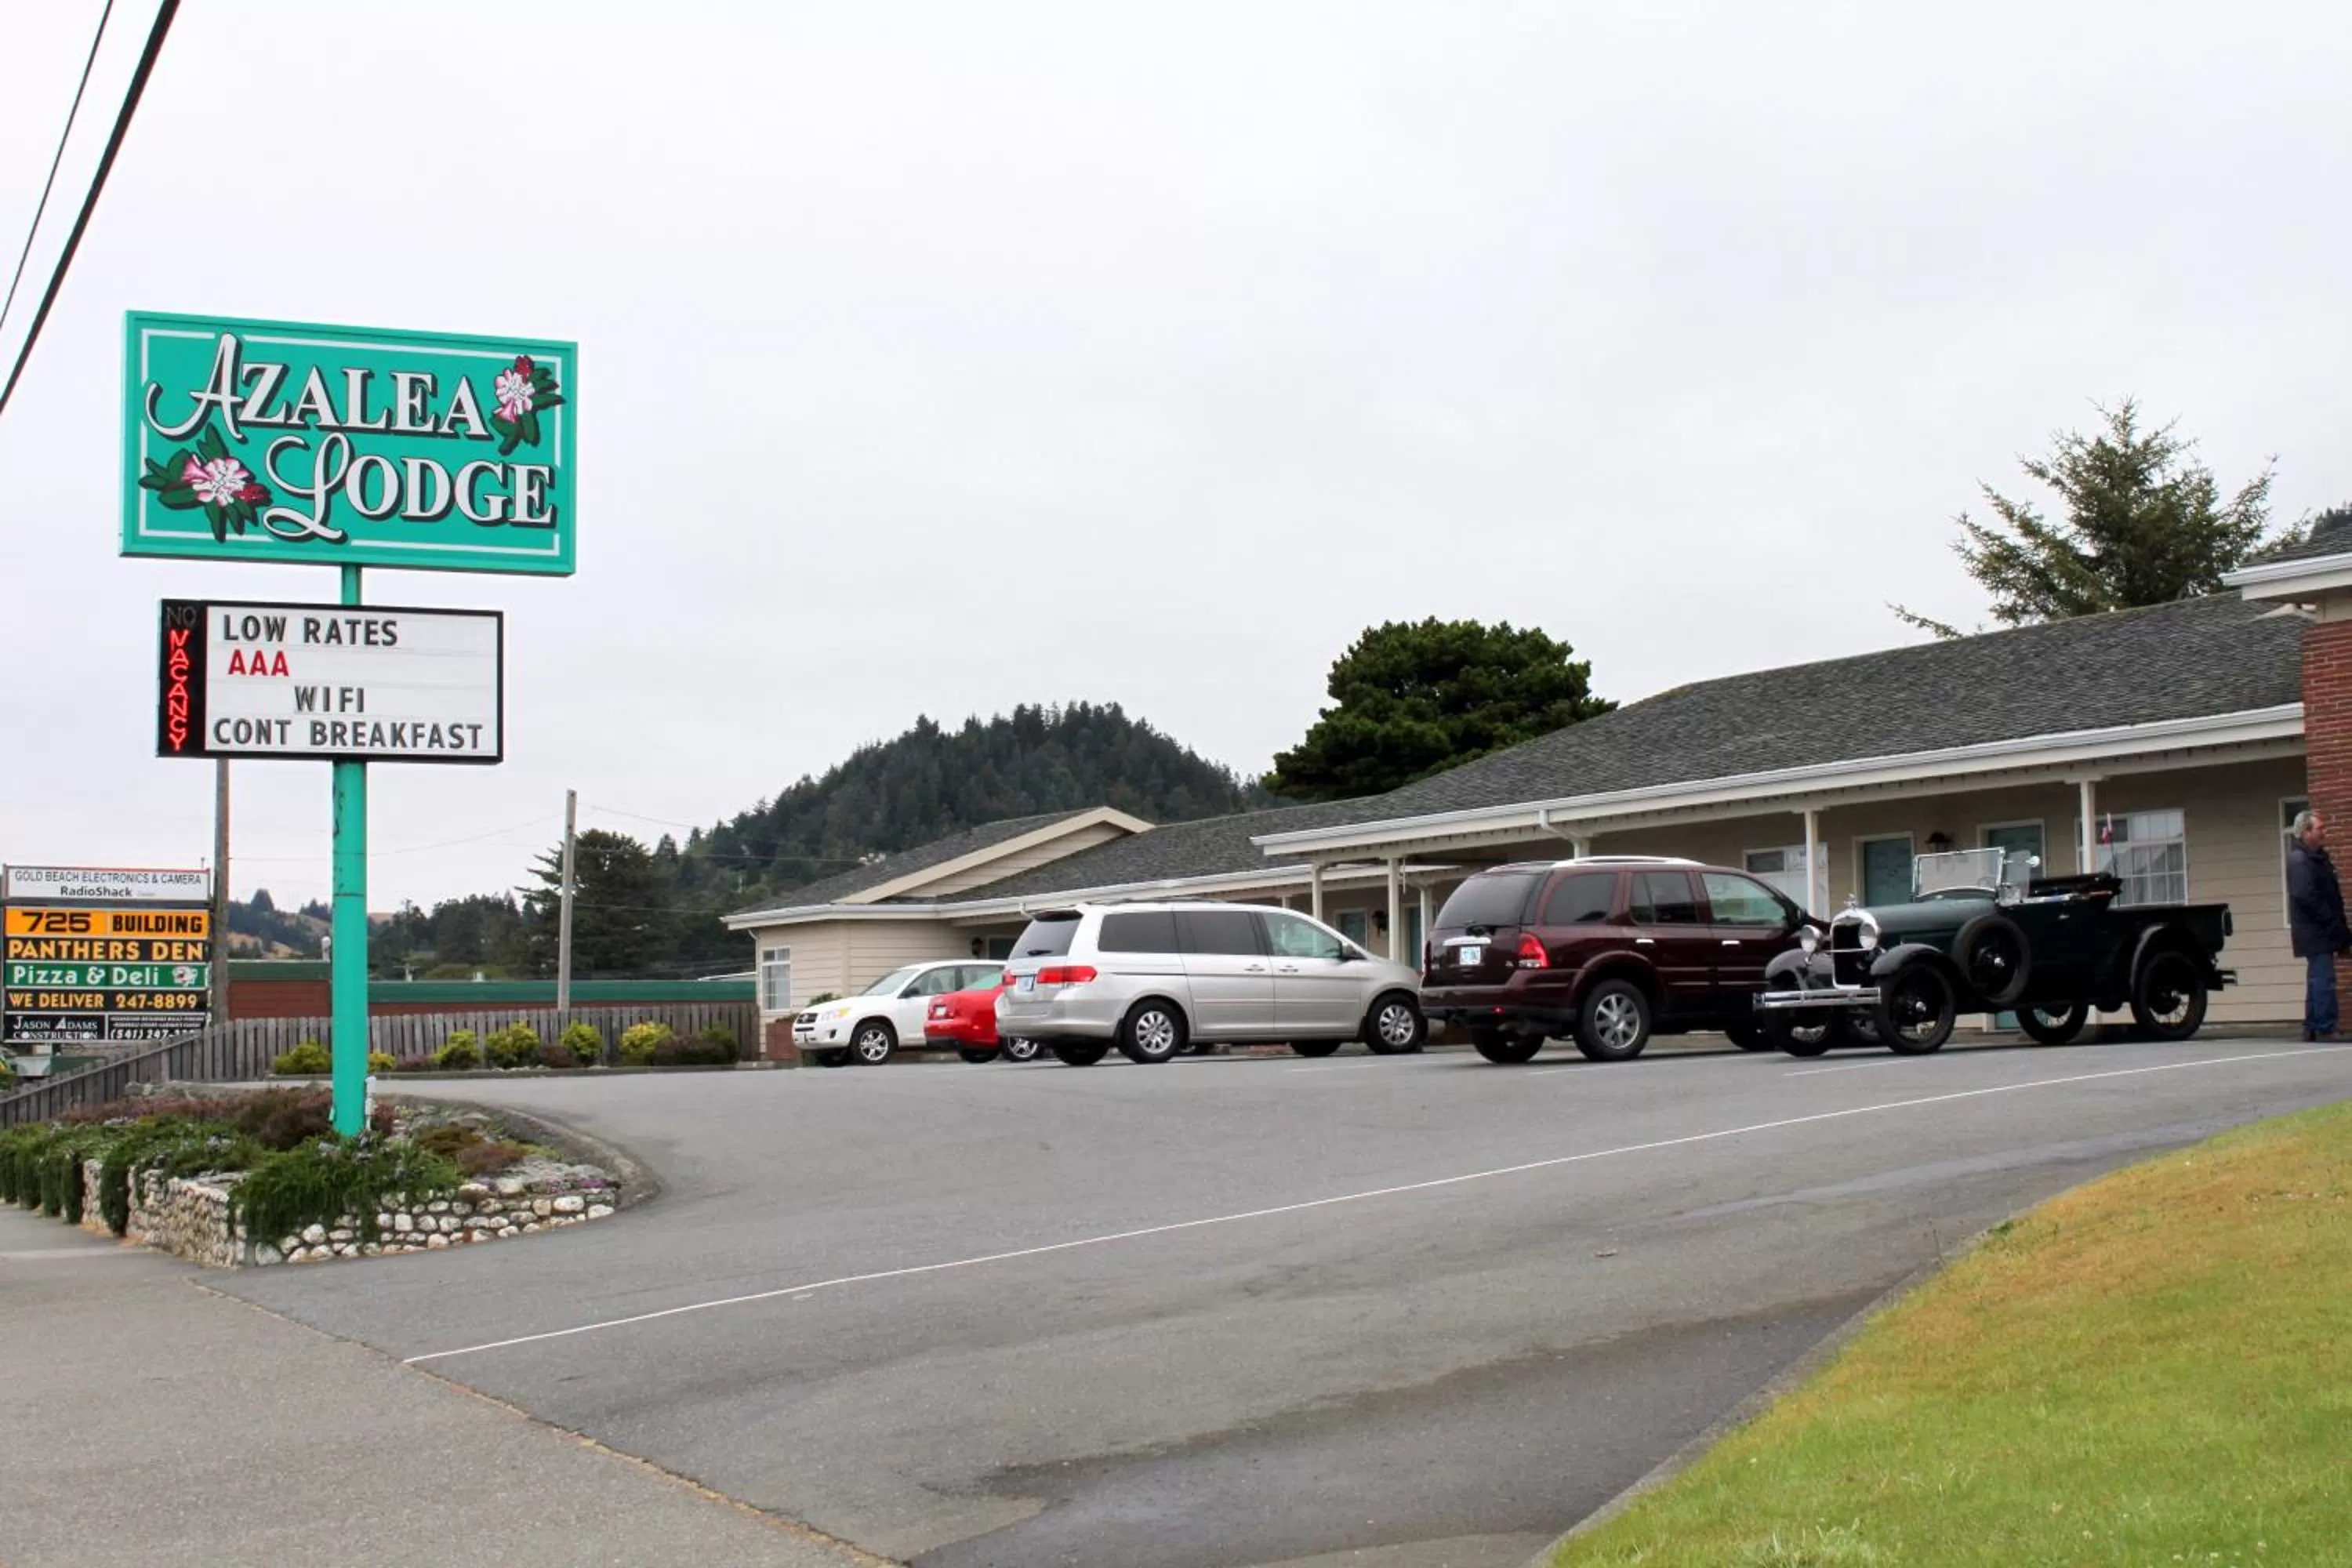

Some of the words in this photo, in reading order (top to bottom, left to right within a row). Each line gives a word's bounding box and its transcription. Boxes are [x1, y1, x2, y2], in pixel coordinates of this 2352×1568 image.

[143, 332, 494, 444] AZALEA
[263, 433, 563, 543] LODGE
[167, 606, 196, 626] NO
[223, 615, 286, 642] LOW
[303, 618, 398, 646] RATES
[228, 649, 289, 677] AAA
[169, 629, 190, 751] VACANCY
[294, 686, 365, 713] WIFI
[213, 718, 292, 745] CONT
[310, 720, 483, 749] BREAKFAST
[15, 871, 43, 882] GOLD
[45, 871, 79, 883] BEACH
[82, 872, 149, 884] ELECTRONICS
[151, 873, 158, 884] &
[161, 874, 201, 885] CAMERA
[60, 885, 132, 898] RadioShack
[22, 912, 92, 932] 725
[112, 915, 202, 933] BUILDING
[9, 939, 140, 960] PANTHERS
[151, 942, 203, 960] DEN
[13, 965, 78, 984] Pizza
[86, 966, 106, 985] &
[112, 967, 159, 985] Deli
[9, 993, 34, 1007] WE
[38, 993, 104, 1008] DELIVER
[115, 993, 198, 1009] 247-8899
